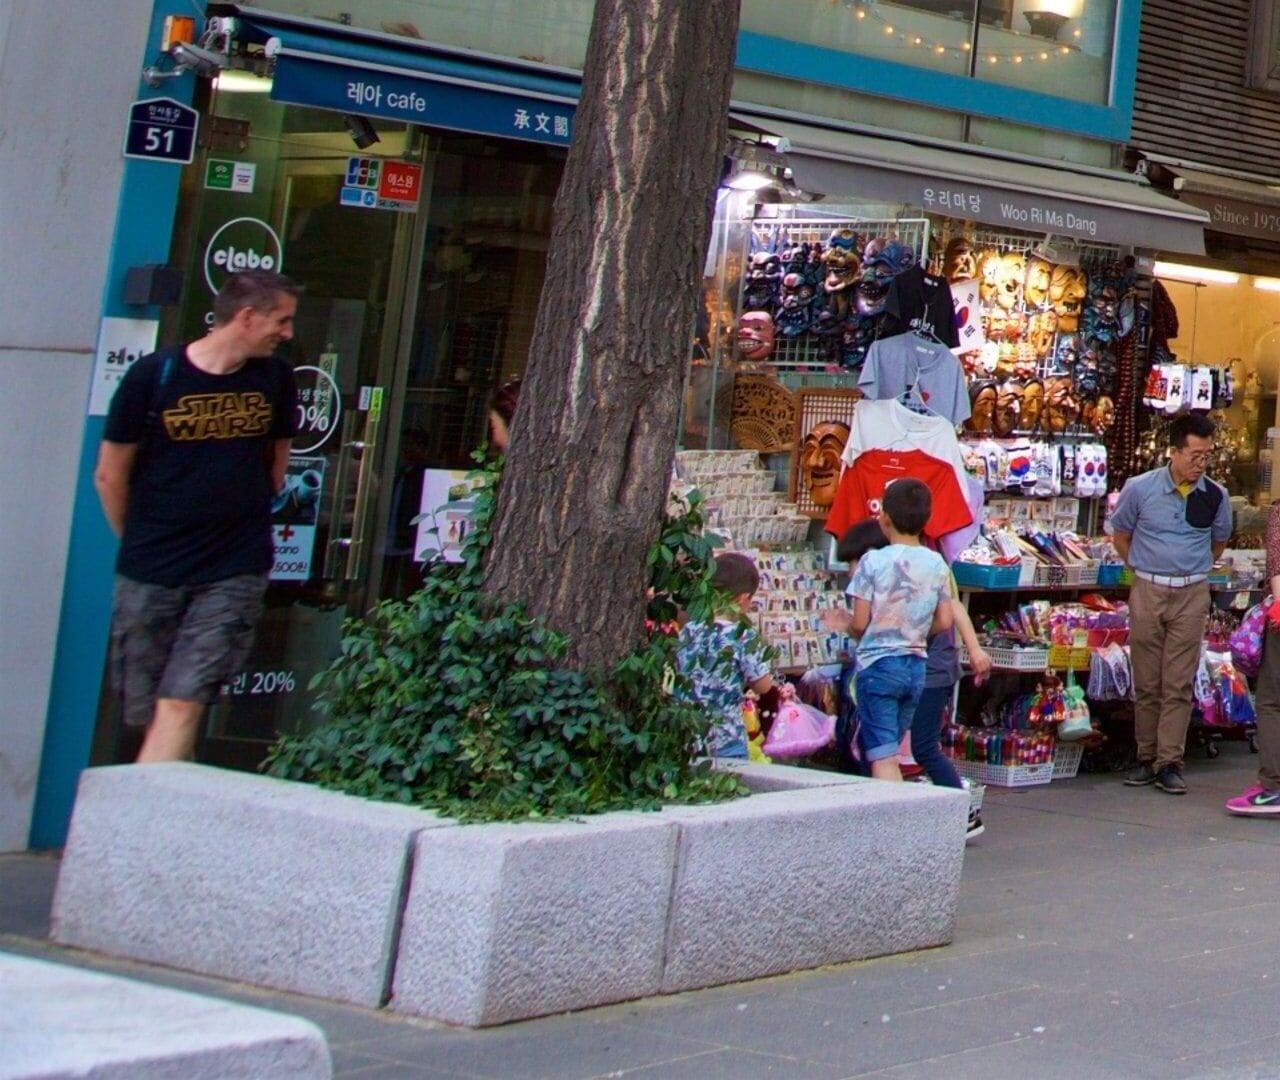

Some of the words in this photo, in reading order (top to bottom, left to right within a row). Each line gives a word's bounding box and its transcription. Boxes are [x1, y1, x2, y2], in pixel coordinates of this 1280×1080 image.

[347, 82, 382, 108] 레아
[387, 92, 426, 112] cafe
[144, 127, 175, 153] 51
[923, 188, 982, 213] 우리마당
[1000, 203, 1028, 222] Woo
[1031, 207, 1043, 224] Ri
[1045, 211, 1064, 228] Ma
[1066, 213, 1097, 236] Dang
[1213, 203, 1249, 226] Since
[213, 246, 274, 273] clabo
[162, 392, 273, 419] STAR
[163, 416, 271, 441] WARS
[251, 670, 296, 695] 20%
